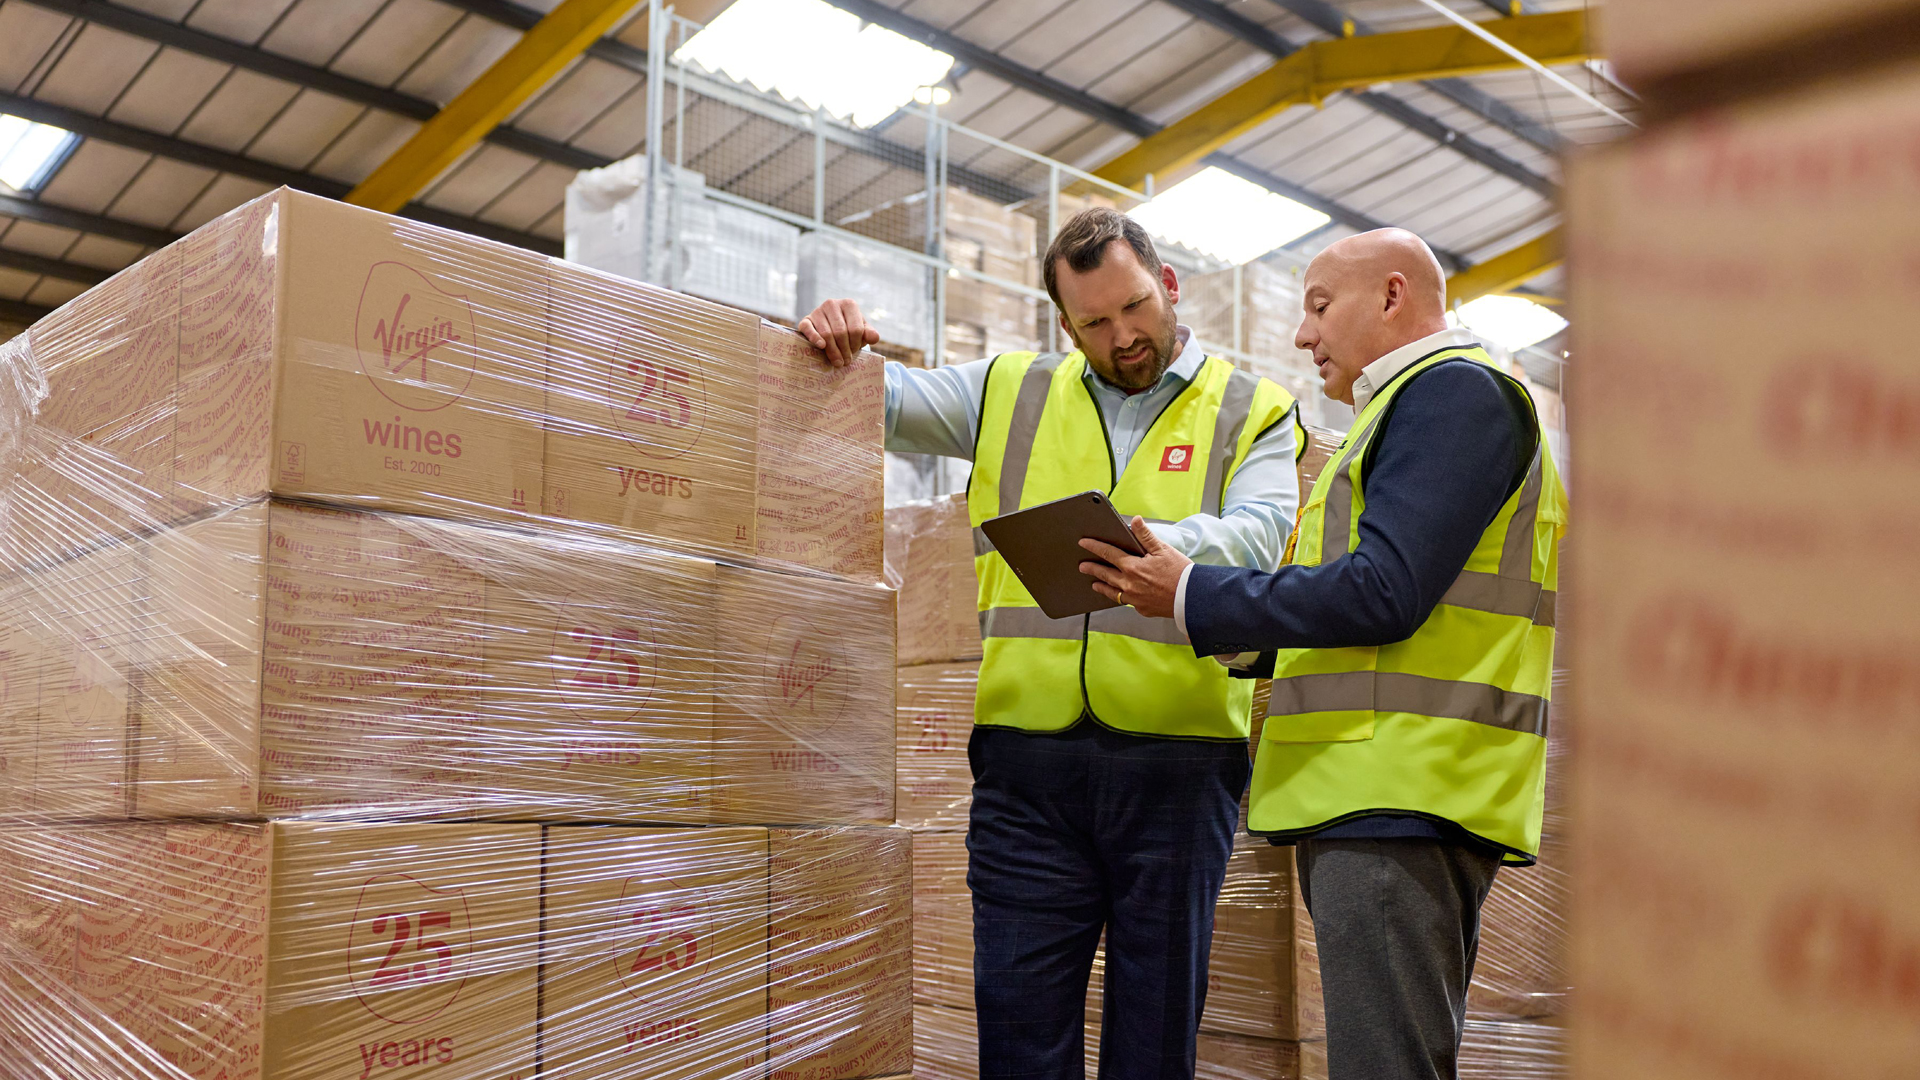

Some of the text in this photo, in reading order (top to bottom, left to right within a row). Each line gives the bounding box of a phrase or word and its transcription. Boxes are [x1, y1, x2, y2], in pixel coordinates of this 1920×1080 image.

[373, 294, 461, 382] Virgin
[625, 359, 691, 430] 25
[363, 416, 462, 458] wines
[384, 456, 441, 477] Est. 2000
[618, 466, 693, 499] years
[332, 586, 349, 604] 25
[569, 627, 640, 692] 25
[777, 640, 838, 712] Virgin
[327, 670, 345, 688] 25
[349, 671, 388, 691] years
[915, 713, 948, 753] 25
[561, 740, 641, 771] years
[770, 744, 840, 773] wines
[369, 912, 453, 986] 25
[630, 905, 698, 972] 25
[821, 927, 833, 940] 25
[834, 921, 860, 941] years
[813, 963, 825, 977] 25
[826, 958, 852, 977] years
[853, 942, 880, 967] young
[623, 1018, 700, 1054] years
[359, 1037, 454, 1080] years
[820, 1067, 832, 1080] 25
[833, 1057, 860, 1078] years
[860, 1038, 889, 1066] young
